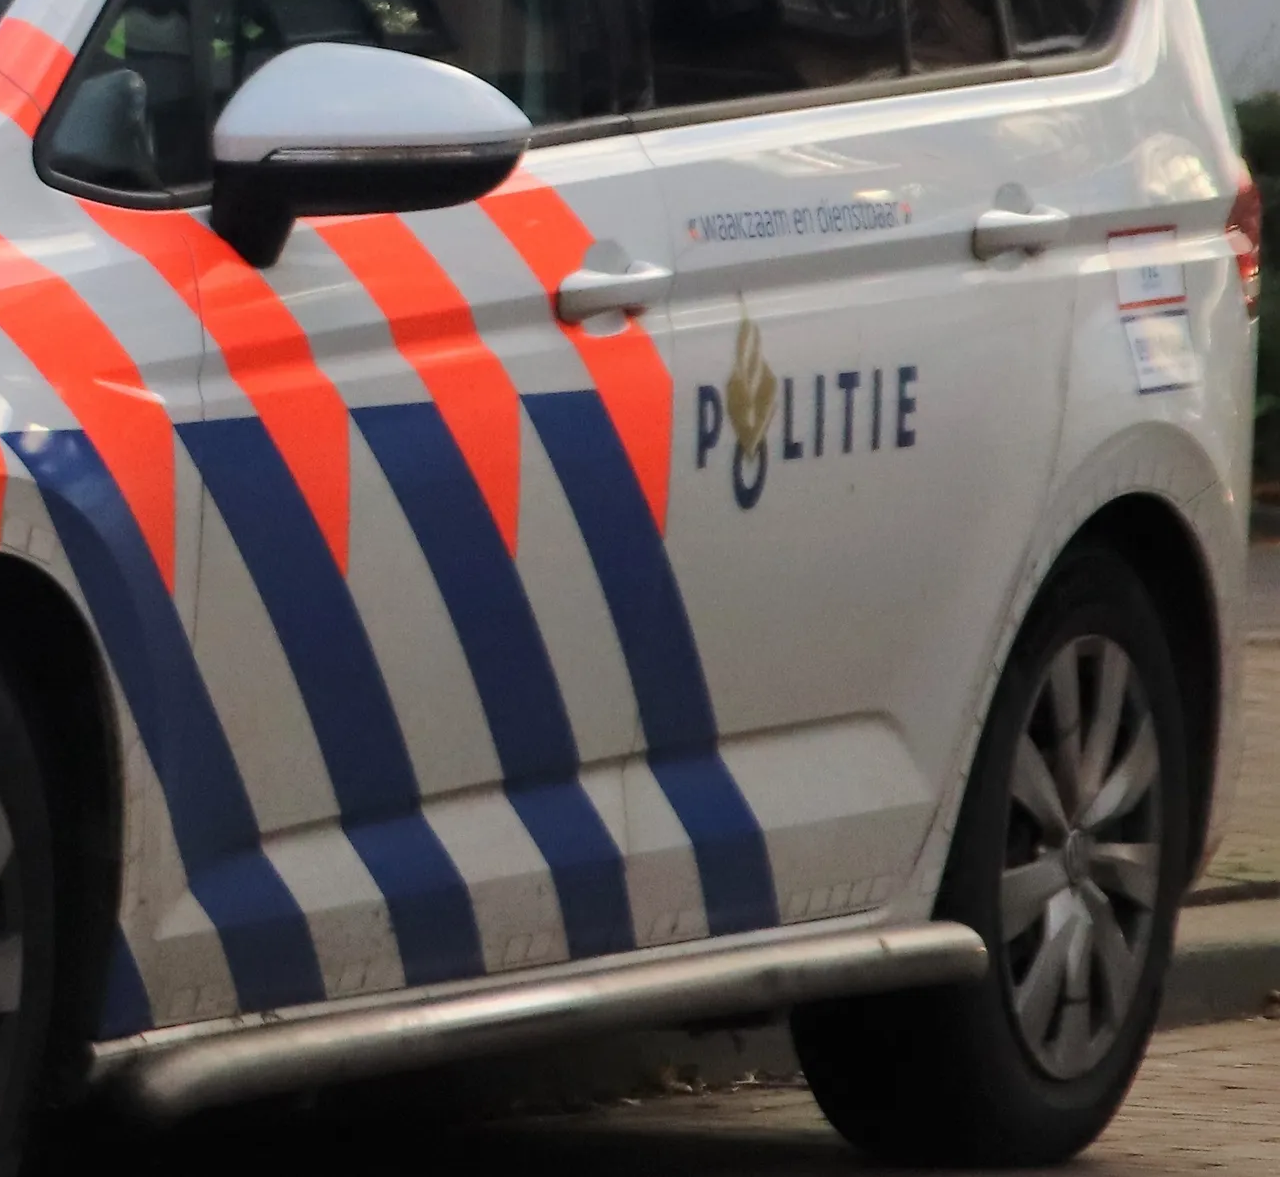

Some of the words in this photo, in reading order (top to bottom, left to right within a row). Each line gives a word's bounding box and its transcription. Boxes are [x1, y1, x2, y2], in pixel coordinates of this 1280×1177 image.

[701, 209, 791, 242] waakzaam
[794, 205, 815, 235] en
[696, 365, 917, 510] POLITIE
